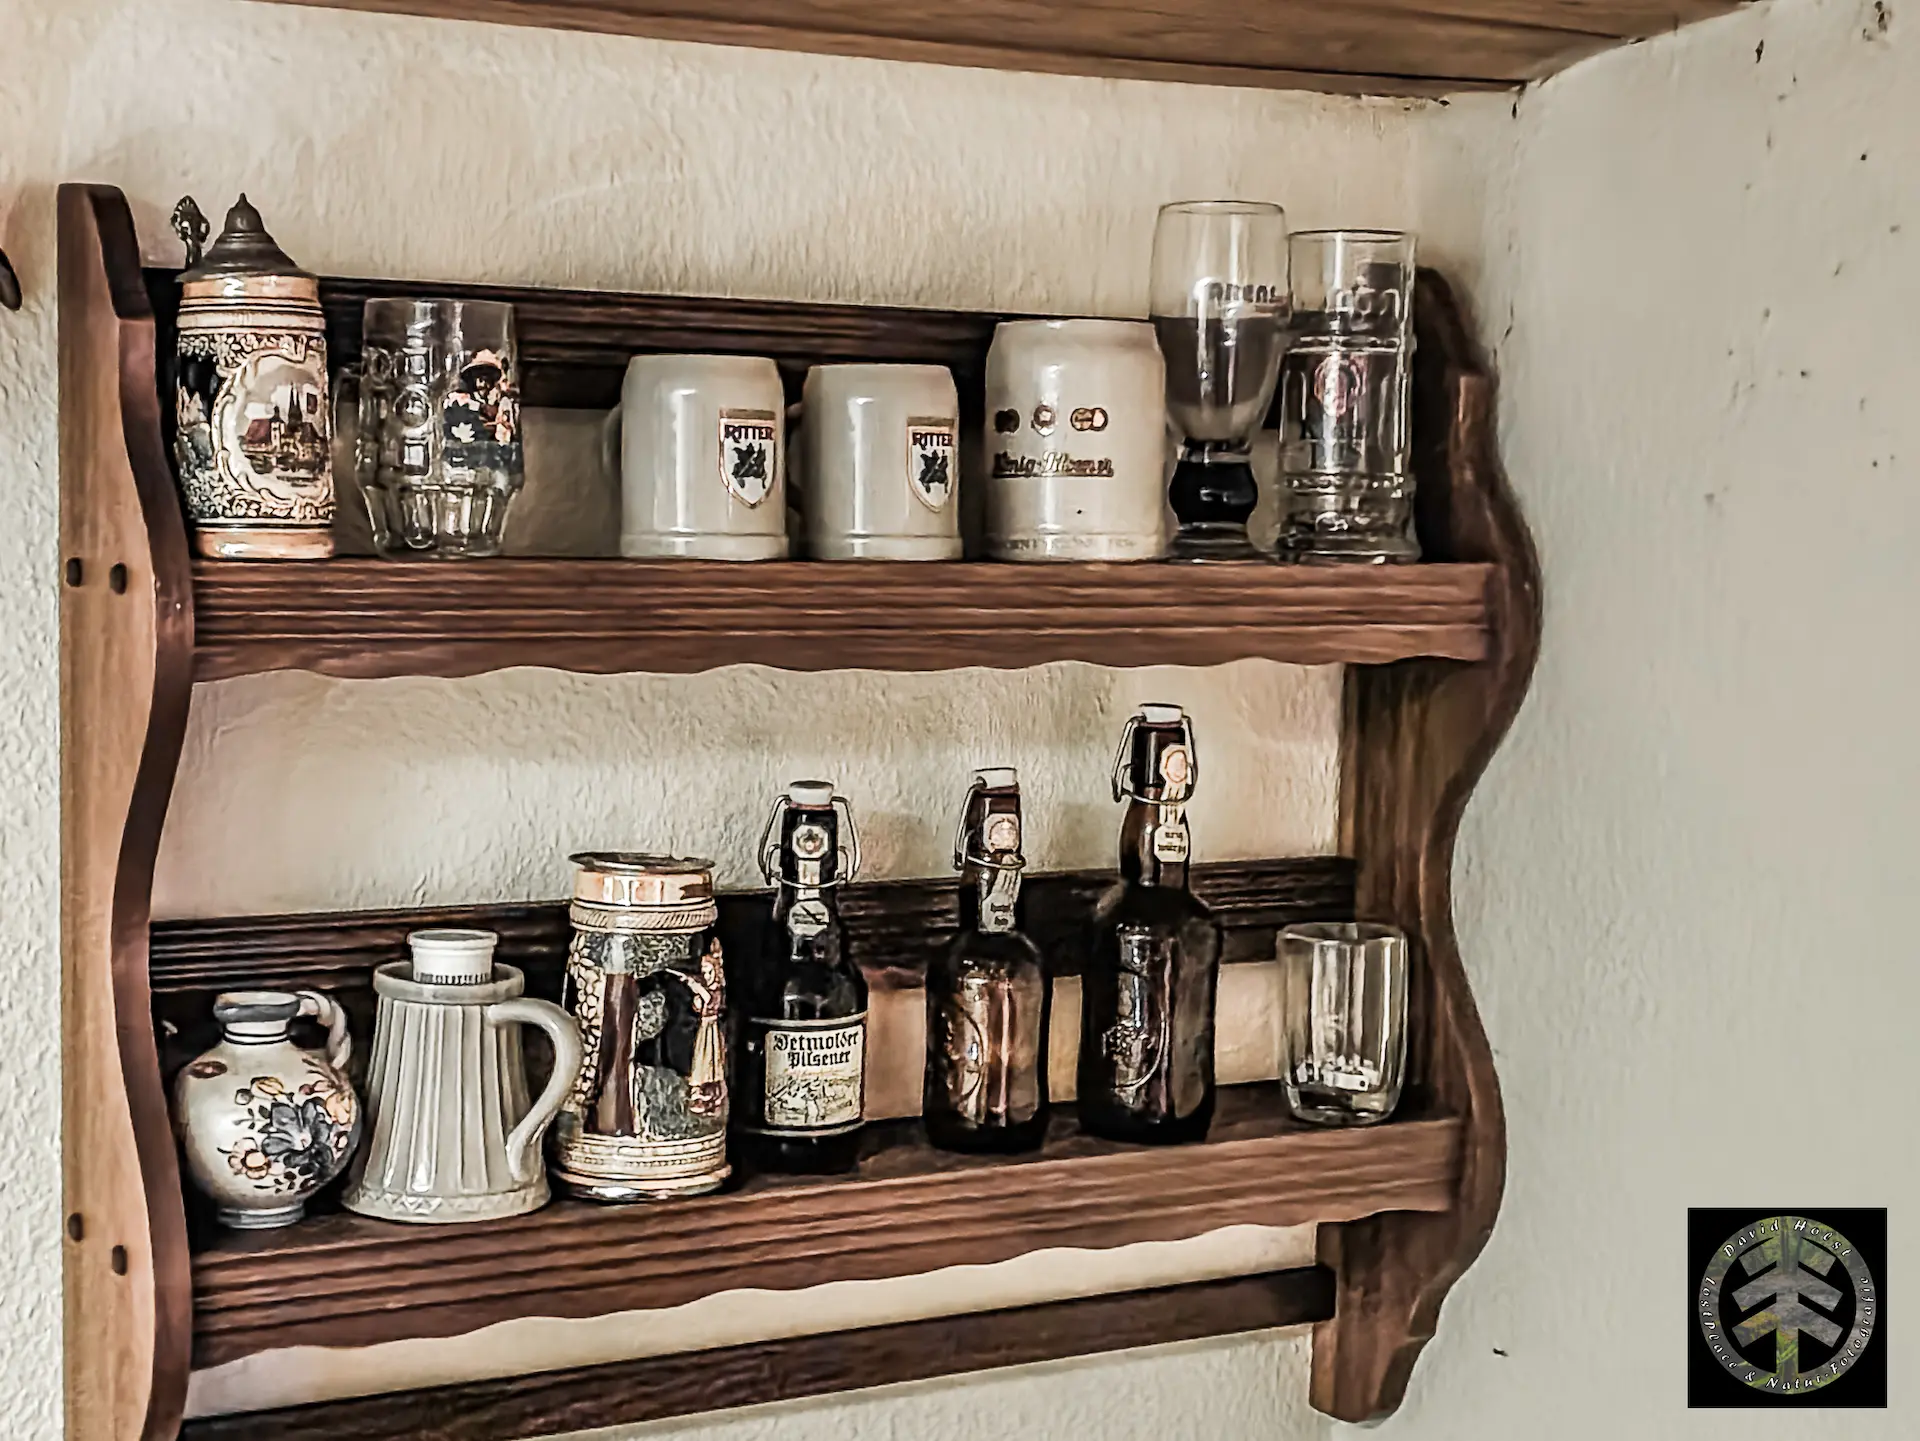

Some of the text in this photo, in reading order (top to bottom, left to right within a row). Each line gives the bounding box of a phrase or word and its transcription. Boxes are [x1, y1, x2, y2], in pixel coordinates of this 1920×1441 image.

[724, 424, 775, 443] RITTER
[912, 431, 954, 450] RITTER
[773, 1031, 859, 1051] Detmolder
[787, 1050, 851, 1069] Pilsener
